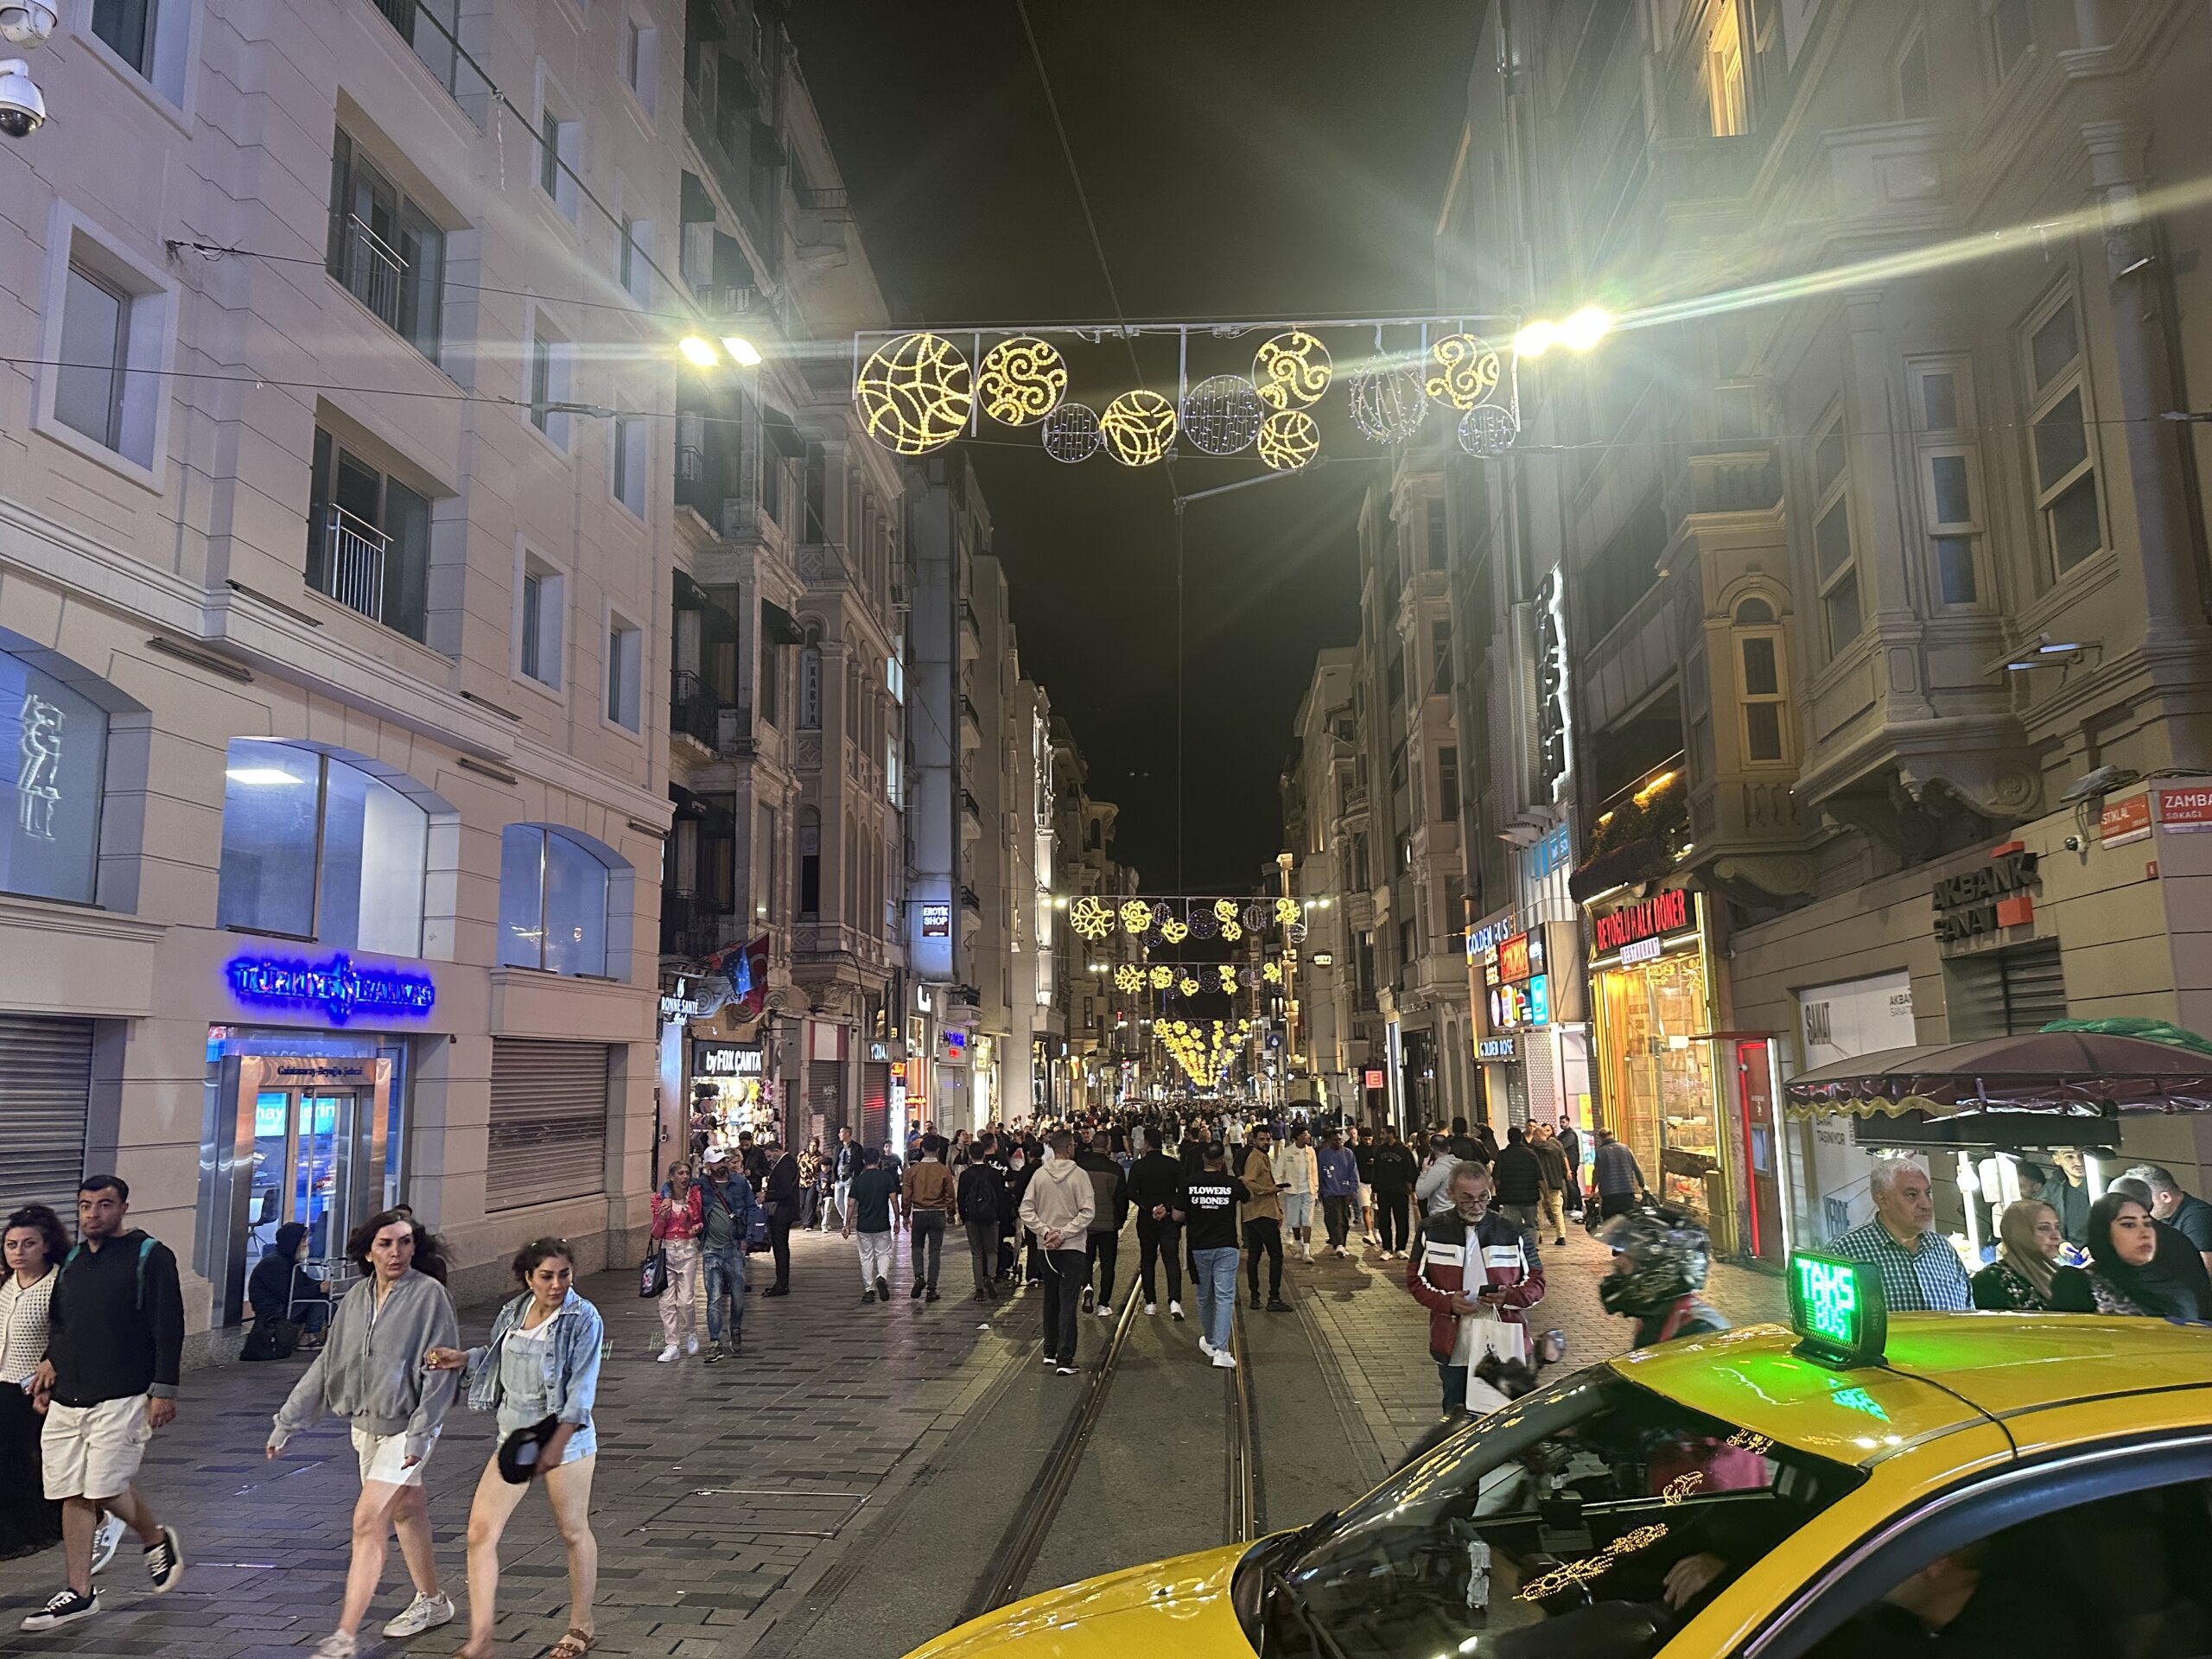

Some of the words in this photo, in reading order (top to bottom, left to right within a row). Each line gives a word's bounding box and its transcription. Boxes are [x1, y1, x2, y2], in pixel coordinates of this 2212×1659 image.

[1932, 851, 2043, 911] AKBANK
[923, 906, 949, 917] EROTİK
[924, 917, 948, 925] SHOP
[1597, 906, 1631, 950] BEYOĞLU
[1630, 899, 1654, 940] HALK
[1653, 888, 1686, 933] DÖNER
[1468, 925, 1493, 955] GOLDEN
[1479, 1040, 1499, 1057] GOLDEN
[1188, 1186, 1232, 1195] FLOWERS
[1191, 1196, 1198, 1205] &
[1199, 1196, 1230, 1205] BONES
